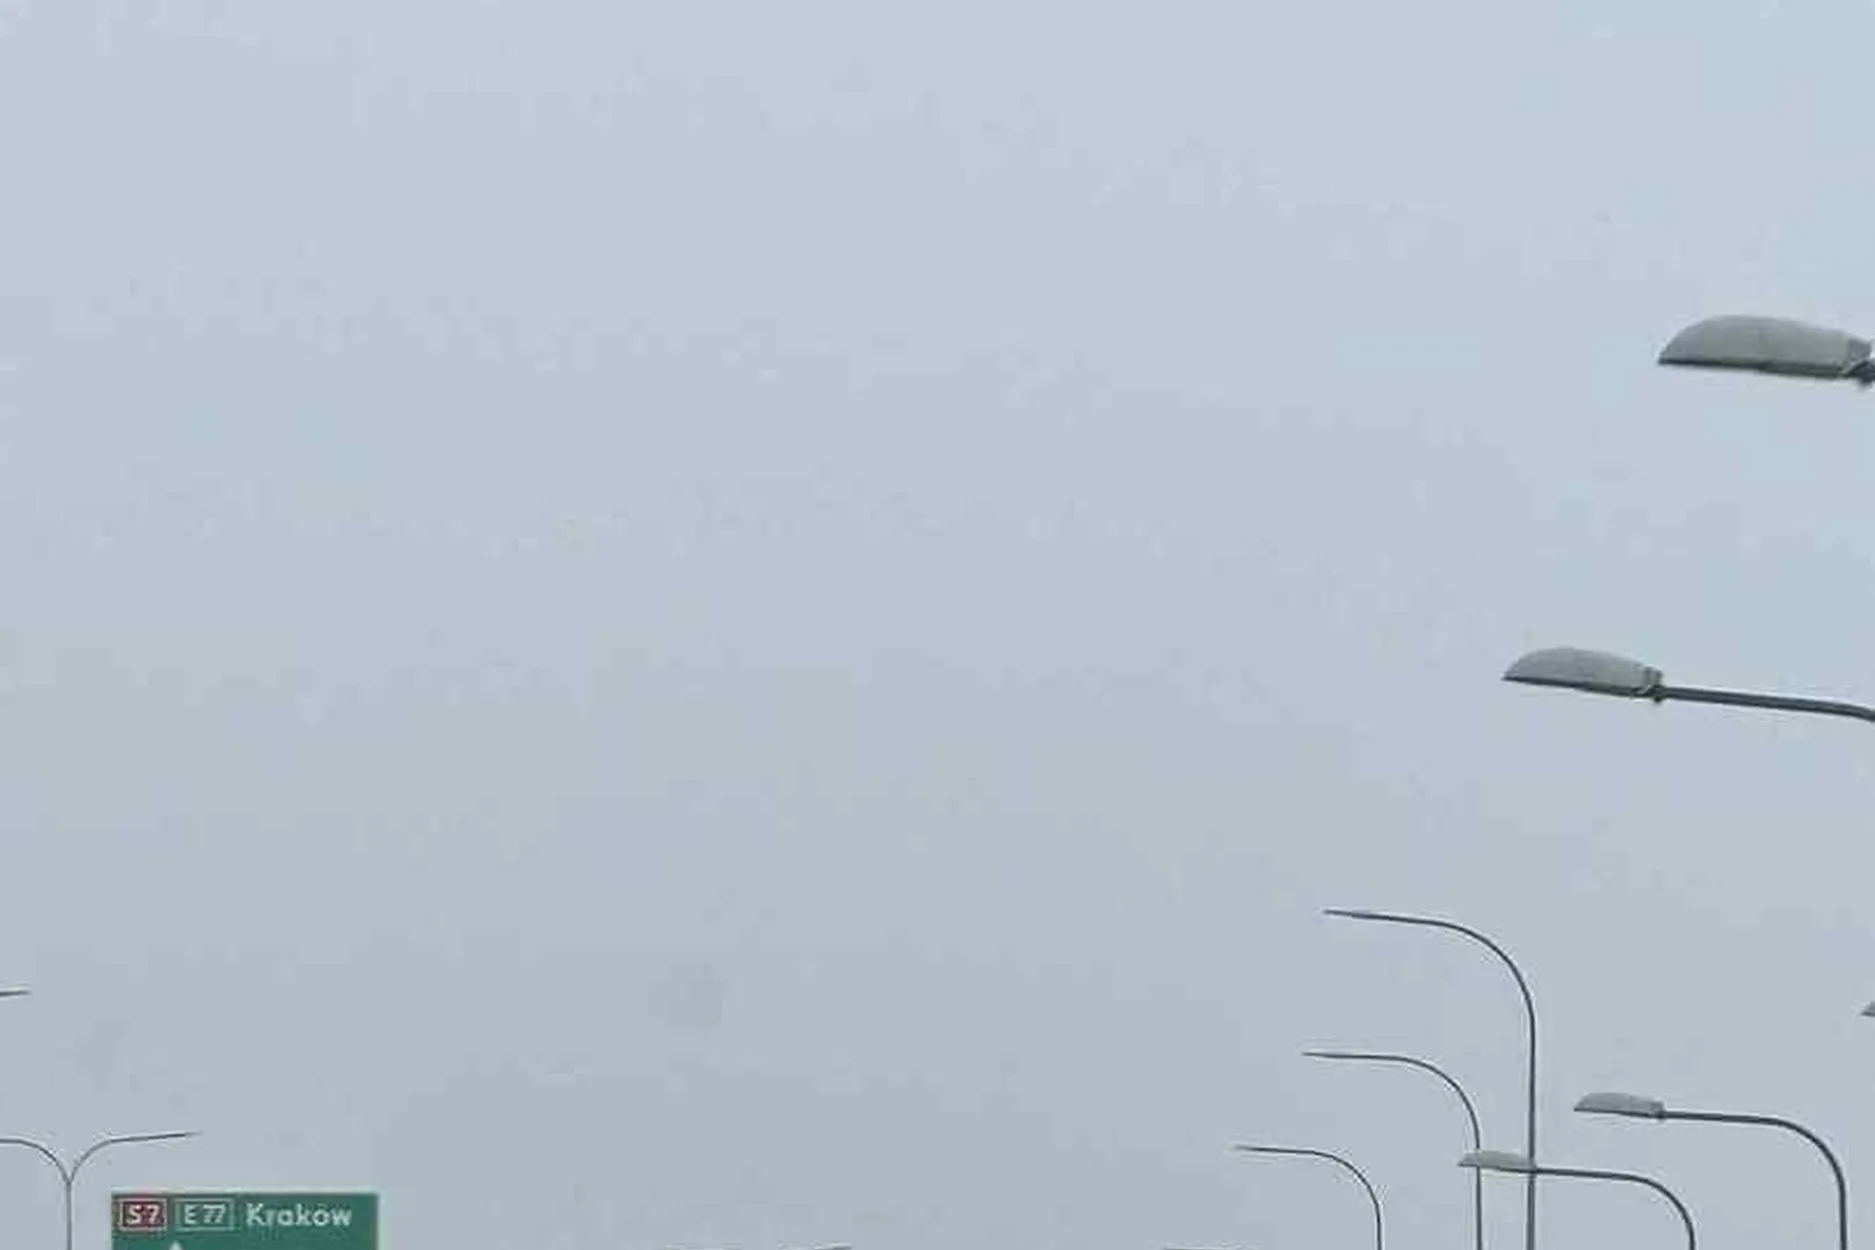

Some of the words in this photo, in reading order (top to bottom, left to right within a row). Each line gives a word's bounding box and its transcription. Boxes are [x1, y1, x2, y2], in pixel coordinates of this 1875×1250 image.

[126, 1204, 160, 1225] S7
[184, 1204, 197, 1224] E
[203, 1204, 226, 1224] 77
